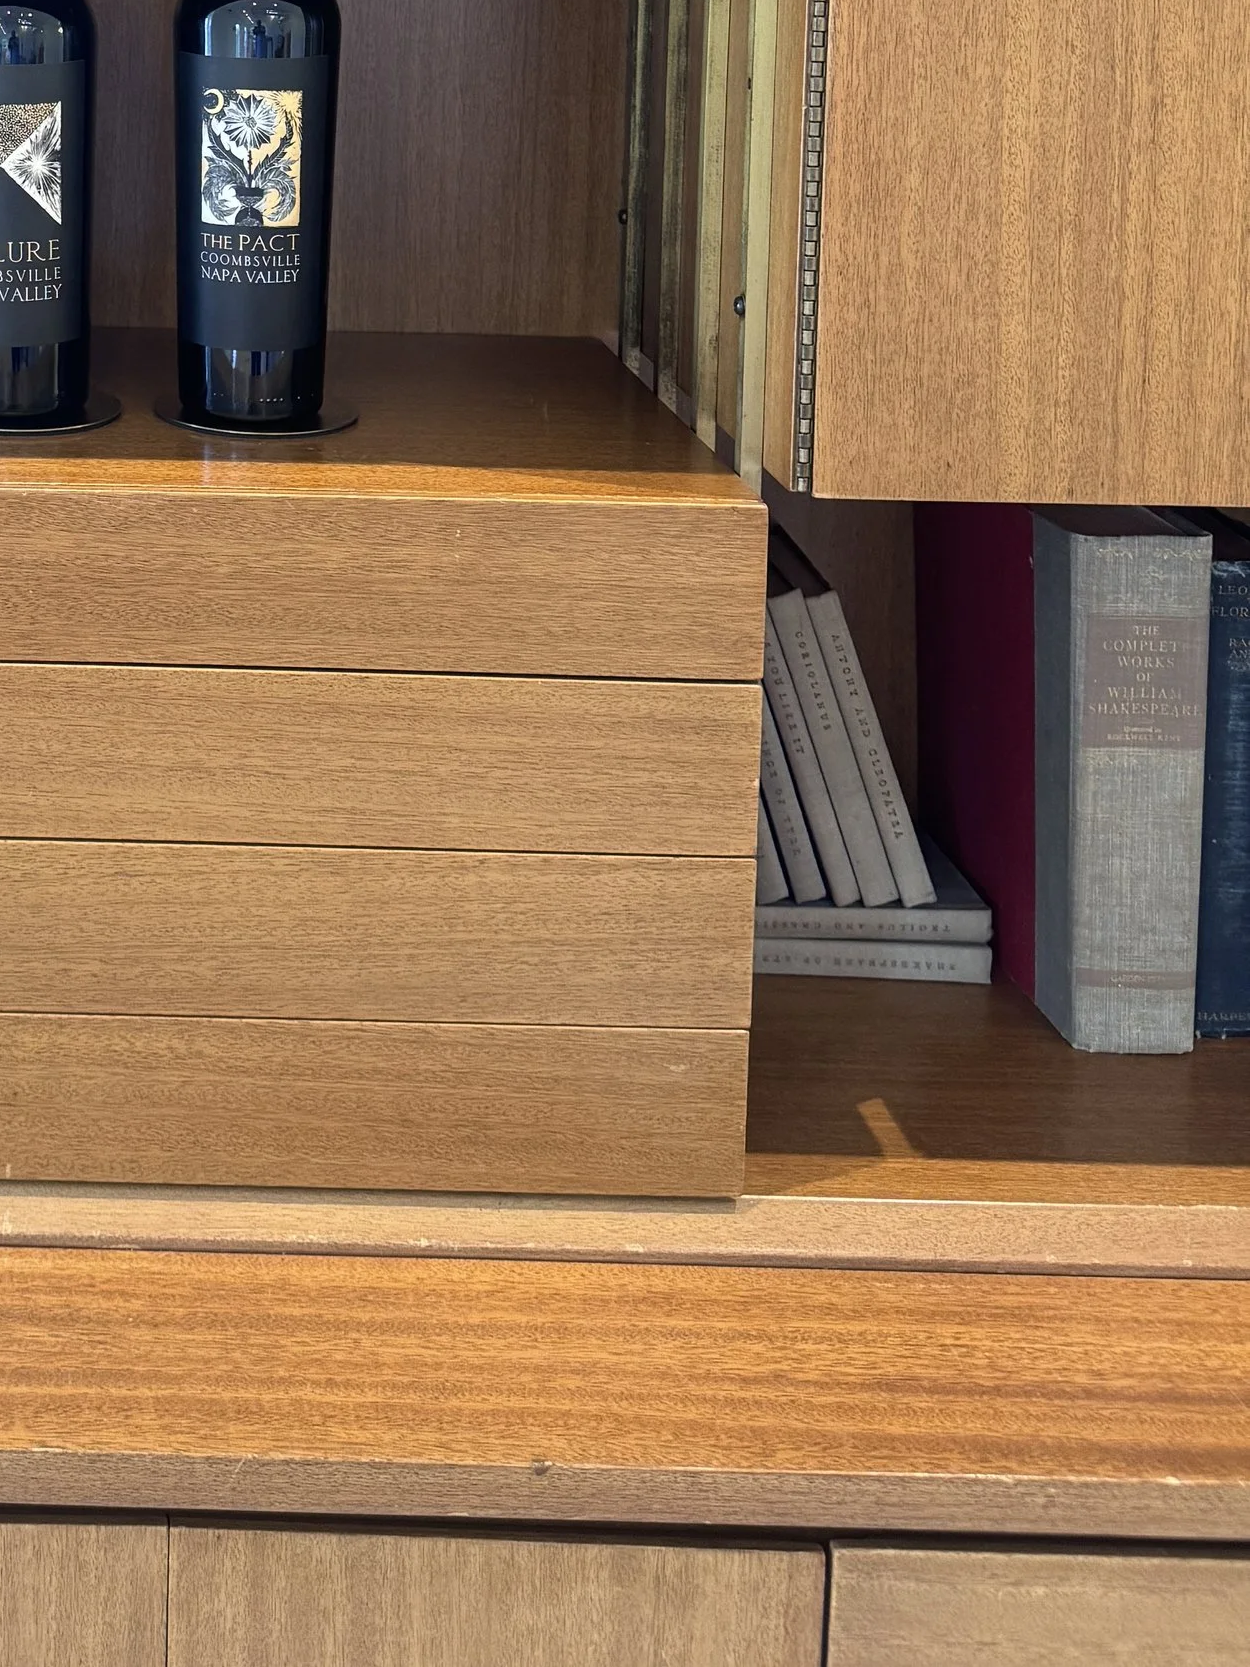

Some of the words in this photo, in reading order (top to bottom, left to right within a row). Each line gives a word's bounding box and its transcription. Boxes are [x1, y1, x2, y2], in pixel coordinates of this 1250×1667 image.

[200, 232, 233, 250] THE
[238, 233, 301, 252] PACT
[200, 250, 301, 268] COOMBSVILLE
[200, 264, 242, 284] NAPA
[245, 268, 300, 284] VALLEY
[1133, 624, 1161, 637] THE
[1117, 654, 1176, 670] WORKS
[794, 630, 833, 733] CORIOLANUS
[1136, 672, 1155, 683] OF
[1108, 686, 1183, 701] WILLIAM
[1088, 702, 1203, 719] SHAKESPEARE
[831, 633, 859, 698] ANTONY
[854, 706, 871, 740] AND
[868, 746, 905, 841] CLEOPATRA
[834, 921, 865, 932] AND
[876, 922, 952, 933] TROILUS
